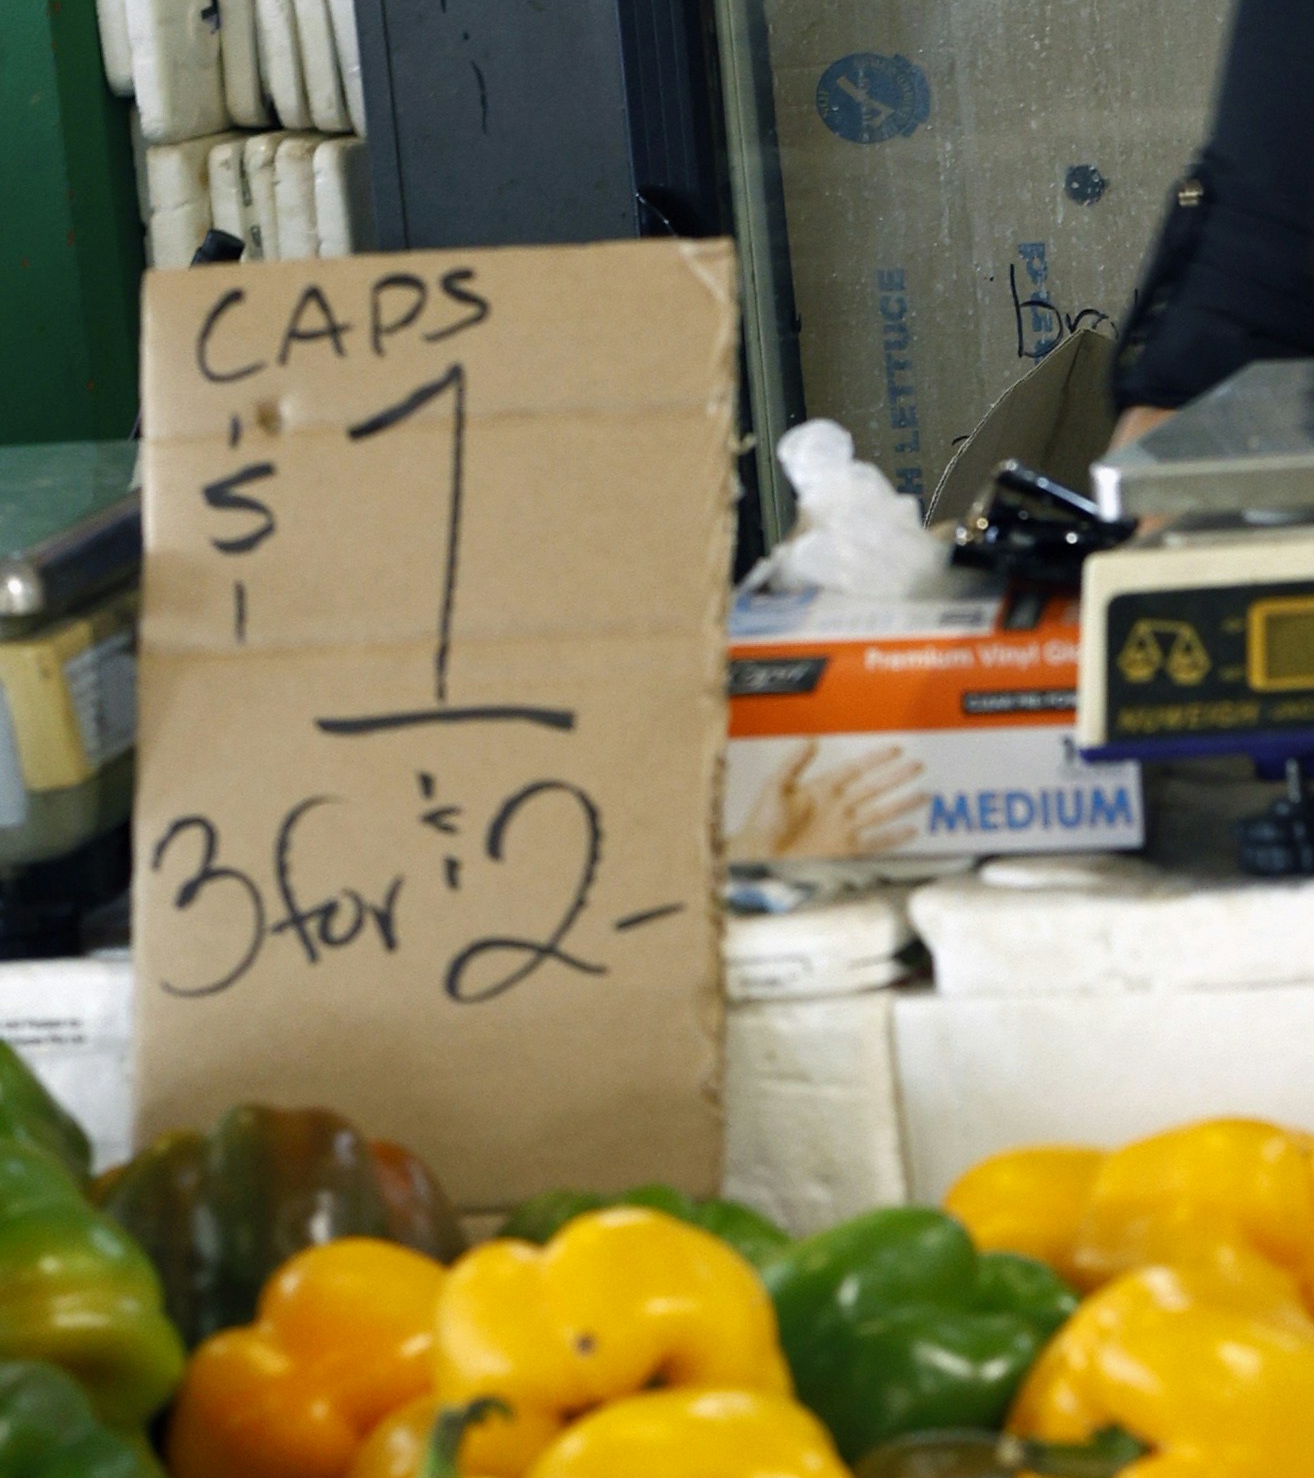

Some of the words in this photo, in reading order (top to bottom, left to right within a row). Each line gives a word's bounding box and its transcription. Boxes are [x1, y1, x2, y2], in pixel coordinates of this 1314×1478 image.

[197, 267, 491, 385] CAPS
[876, 267, 921, 453] LETTUCE
[863, 646, 975, 672] Premium
[977, 642, 1041, 670] Vinyl
[926, 785, 1134, 835] MEDIUM
